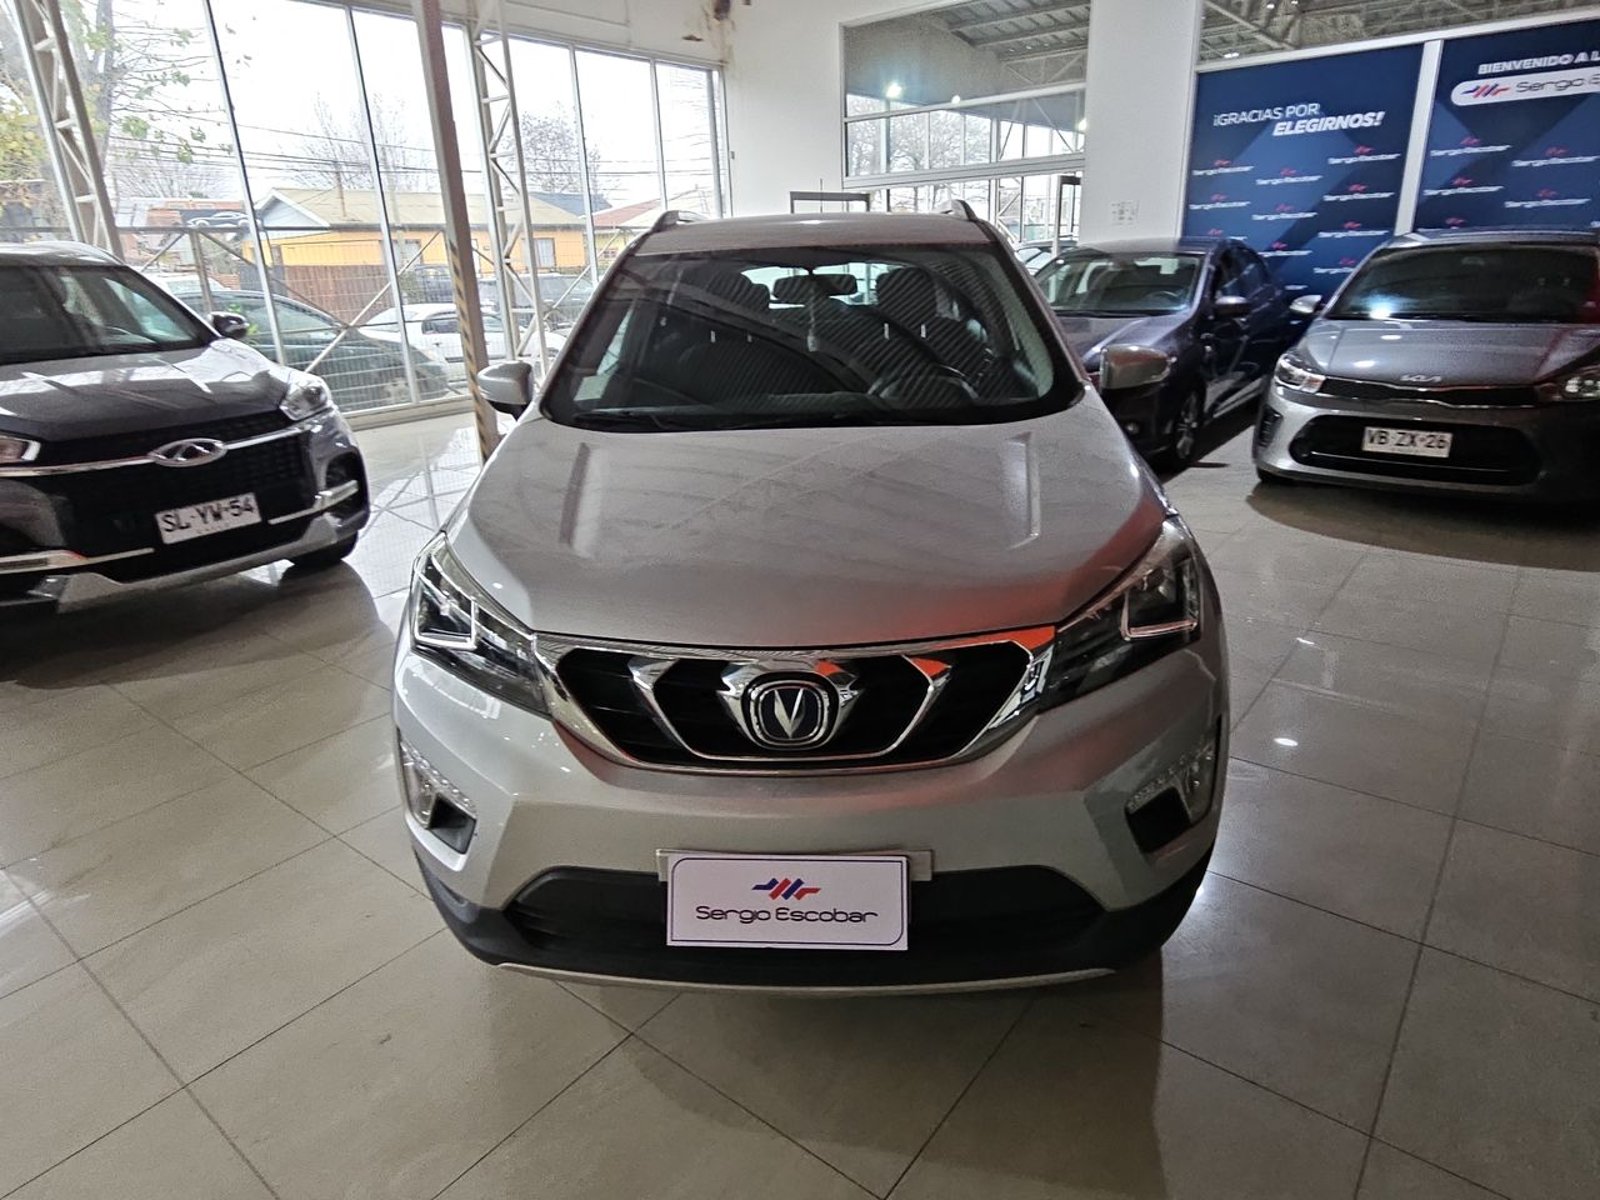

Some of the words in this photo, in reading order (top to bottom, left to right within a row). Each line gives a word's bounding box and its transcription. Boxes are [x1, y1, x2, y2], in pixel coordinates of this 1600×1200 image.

[1477, 54, 1574, 75] BIENVENIDO
[1213, 106, 1283, 127] ¡GRACIAS
[1285, 102, 1321, 118] POR
[1272, 111, 1386, 137] ELEGIRNOS!
[696, 905, 771, 925] Sergio
[775, 907, 878, 923] Escobar
